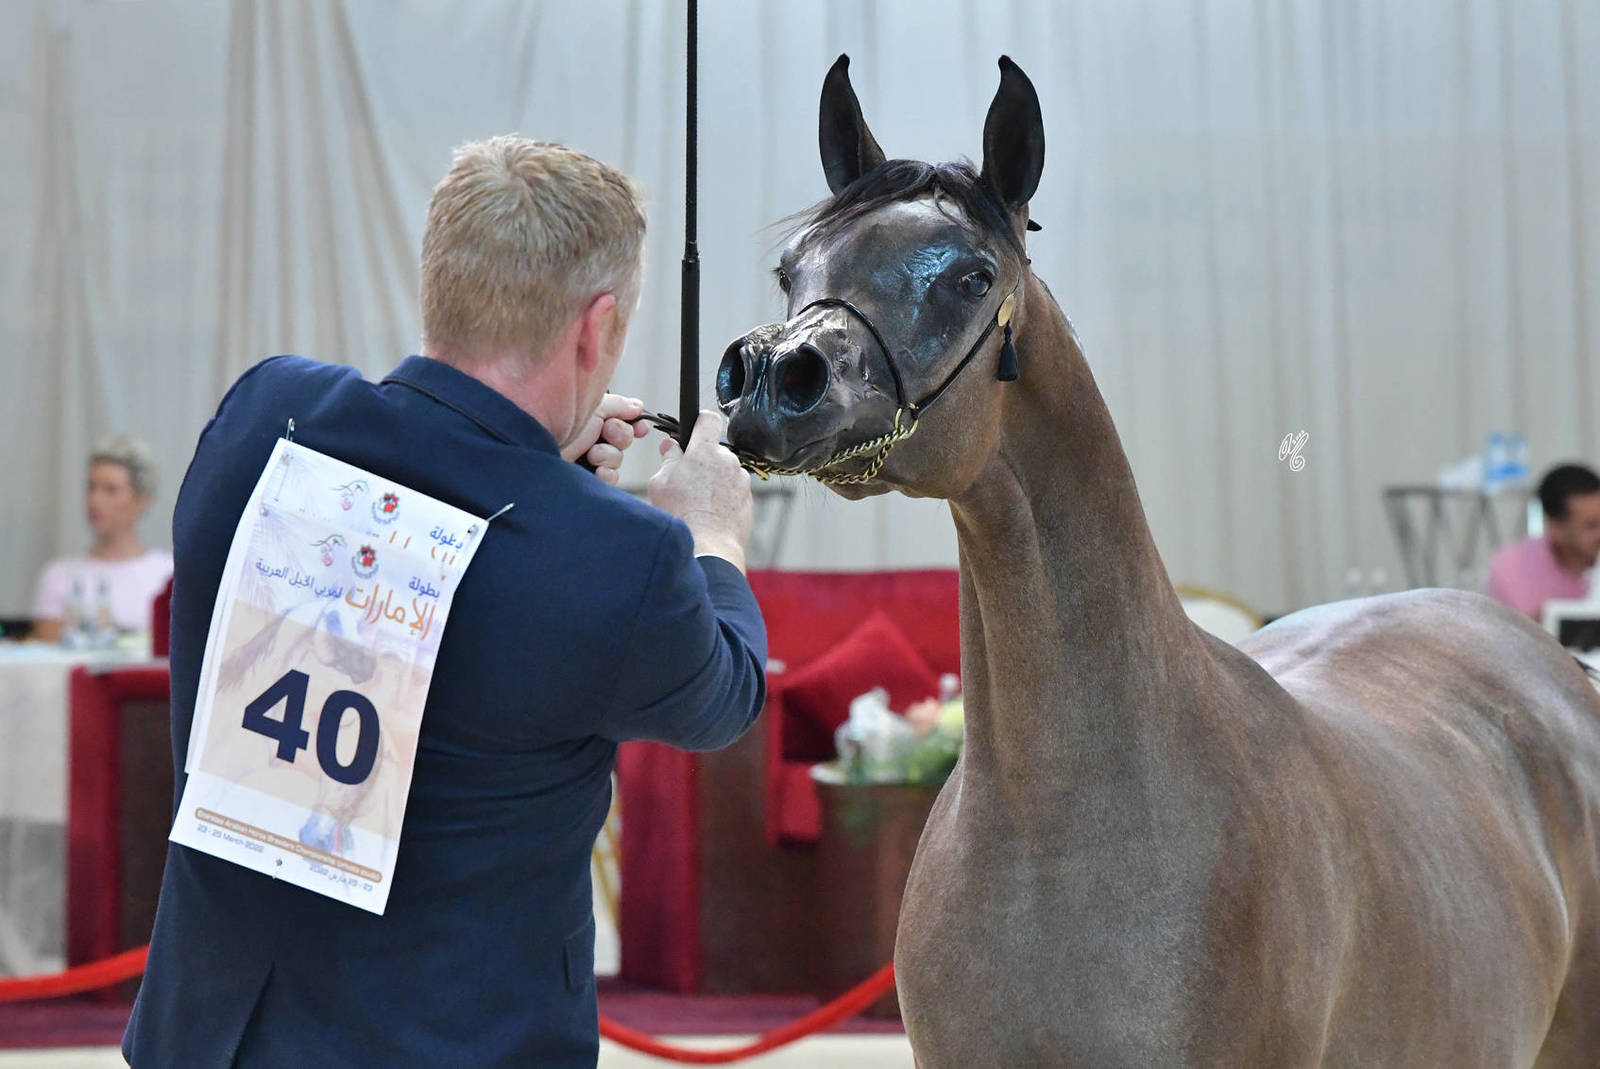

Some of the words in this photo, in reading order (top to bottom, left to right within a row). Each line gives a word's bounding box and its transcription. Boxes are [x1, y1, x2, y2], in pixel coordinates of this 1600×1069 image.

[256, 557, 289, 580] العربية
[289, 570, 315, 589] الخيل
[314, 584, 344, 600] لمربي
[409, 575, 440, 602] بطولة
[345, 584, 436, 641] الإمارات
[242, 669, 381, 786] 40
[223, 832, 244, 846] March
[245, 840, 265, 854] 2022
